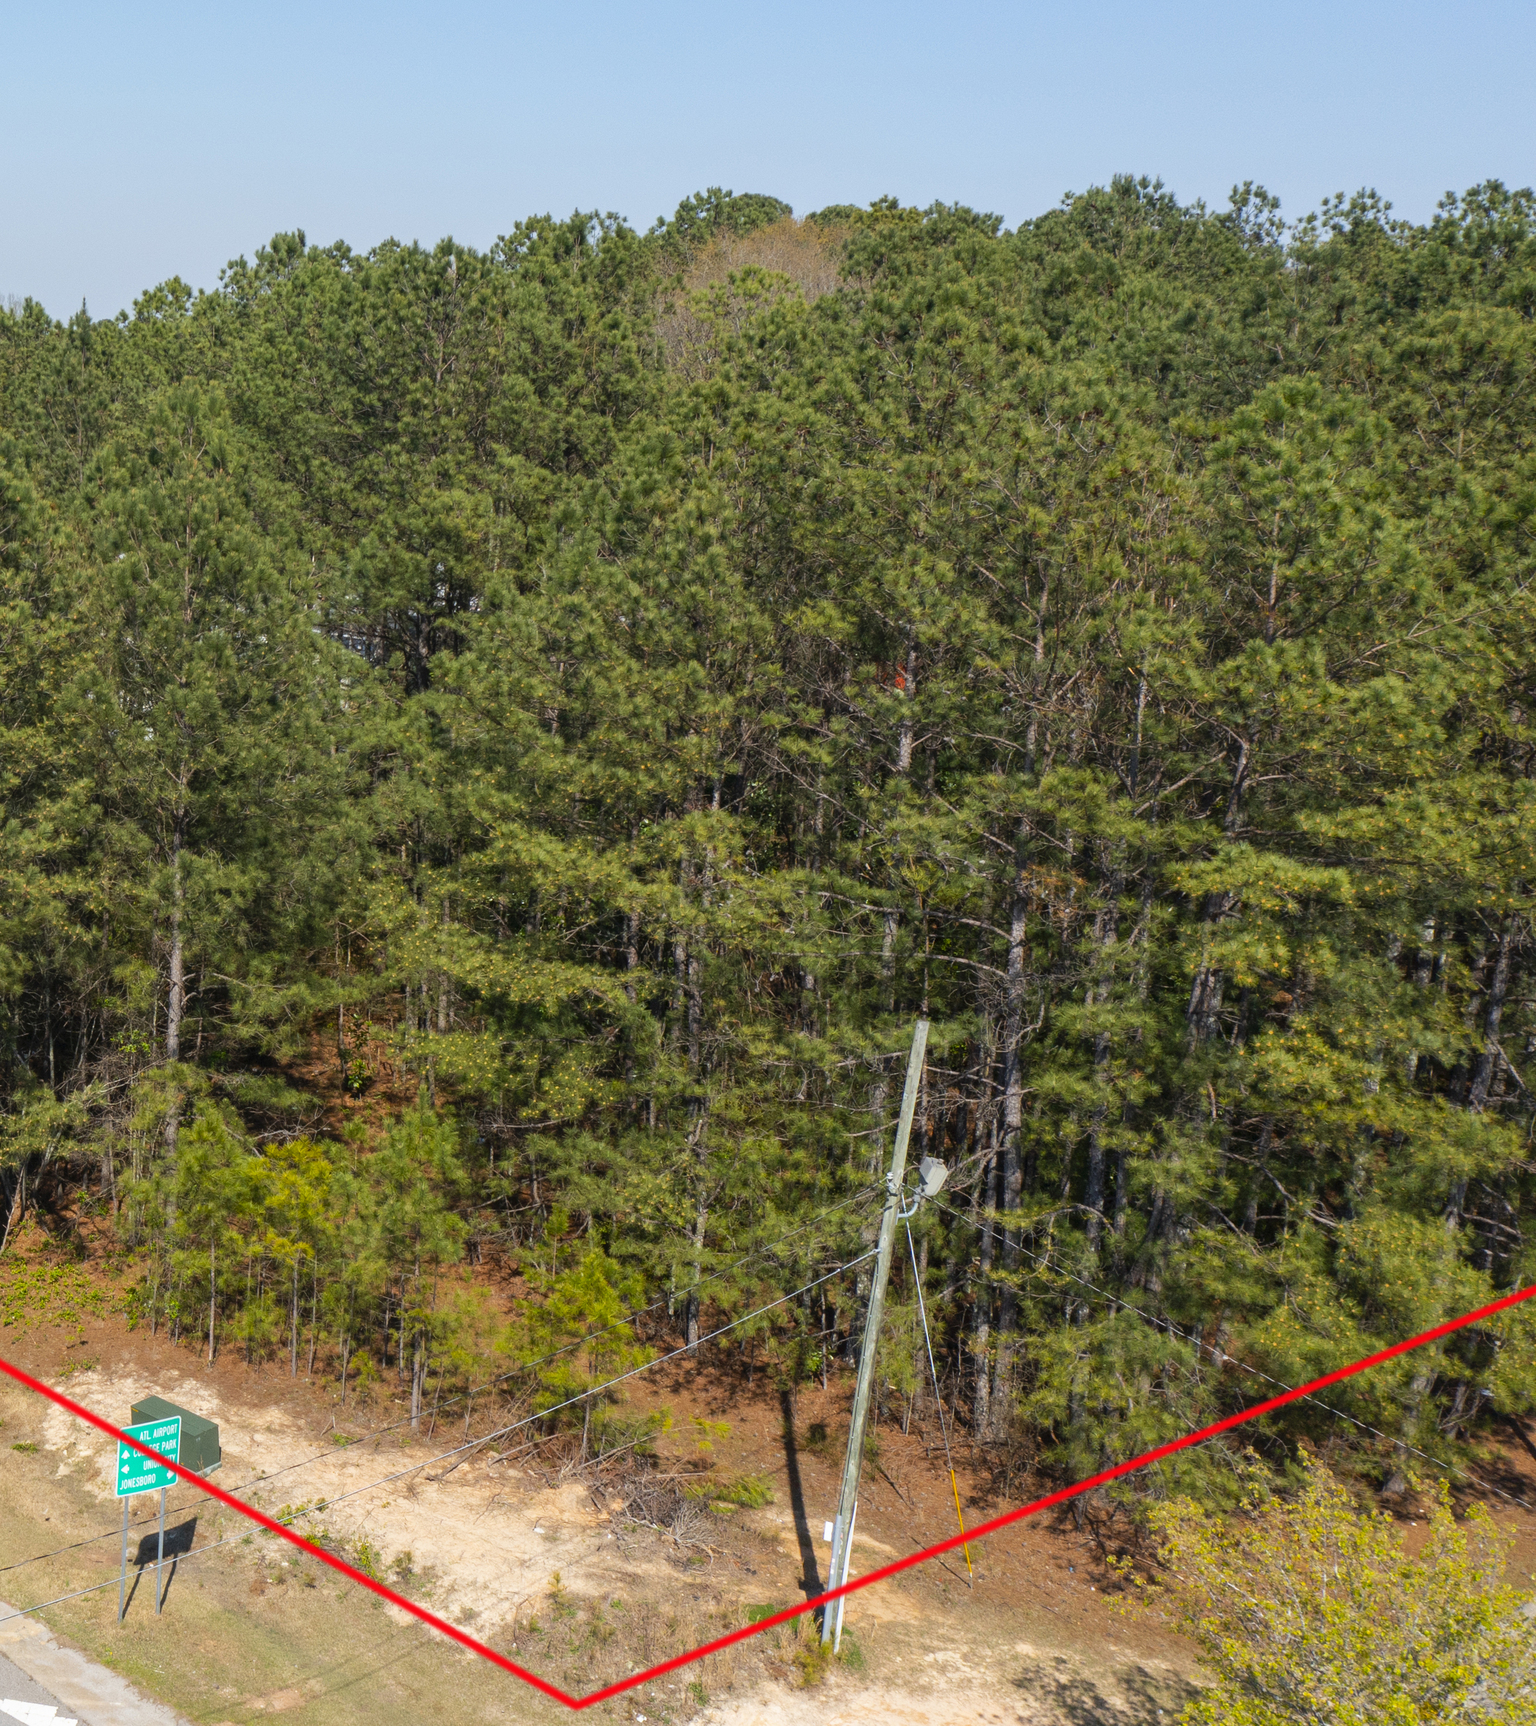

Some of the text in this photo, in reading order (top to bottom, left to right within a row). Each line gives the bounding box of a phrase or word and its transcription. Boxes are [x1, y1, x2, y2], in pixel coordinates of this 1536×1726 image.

[139, 1424, 177, 1441] ATL AIRPORT
[161, 1439, 177, 1451] PARK
[120, 1474, 156, 1490] JONESBORO
